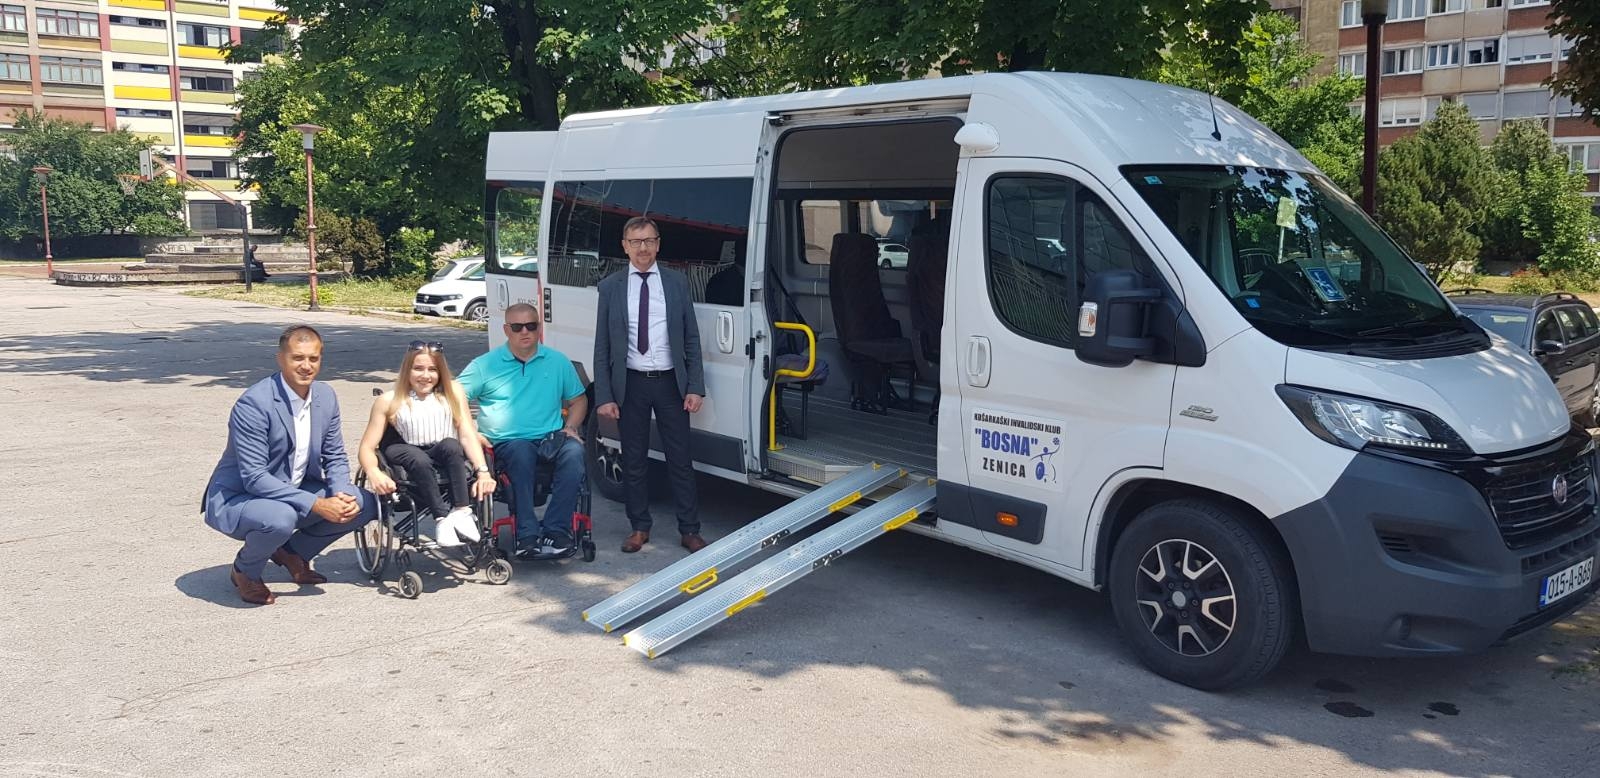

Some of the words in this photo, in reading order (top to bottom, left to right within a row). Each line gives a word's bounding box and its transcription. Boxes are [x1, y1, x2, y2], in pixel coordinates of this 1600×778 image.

[1010, 418, 1044, 432] INVALIDSKI
[1045, 424, 1061, 434] KLUB
[975, 427, 1038, 457] "BOSNA"
[982, 456, 1026, 478] ZENICA
